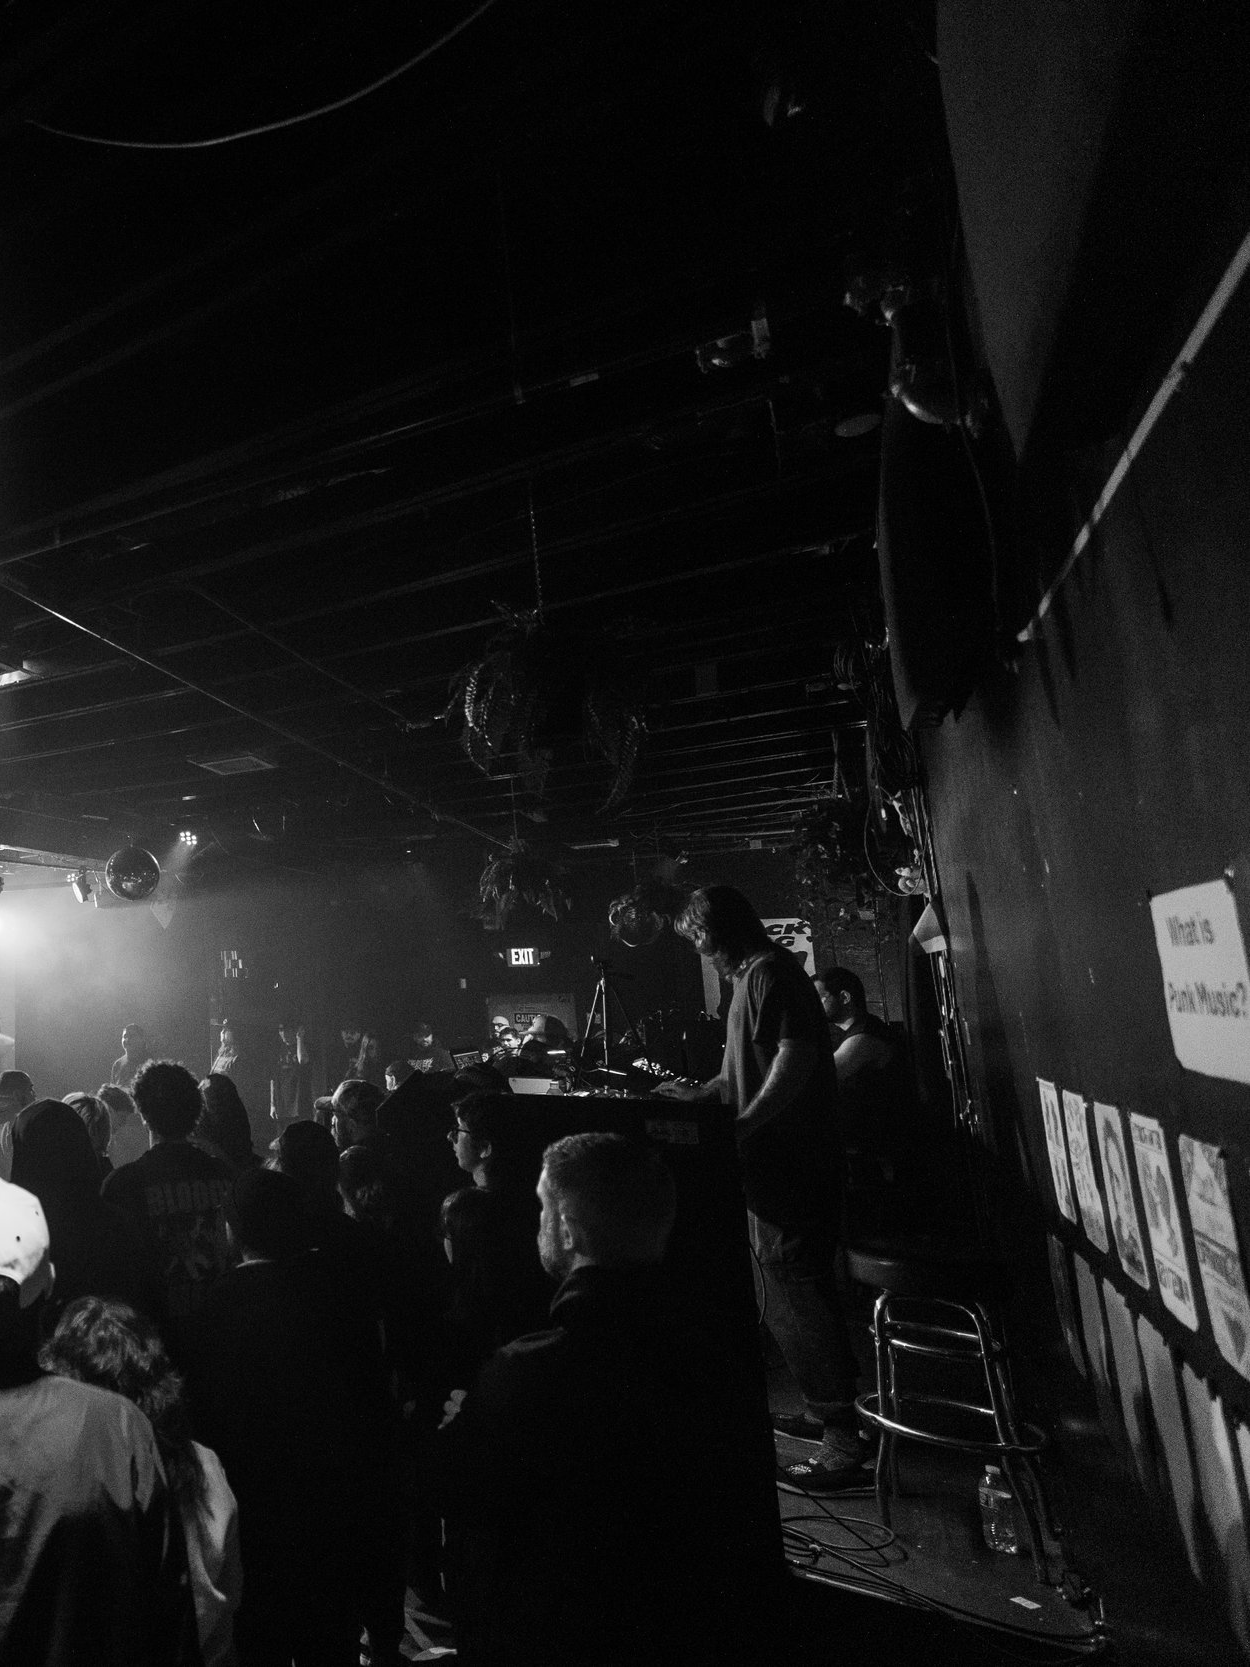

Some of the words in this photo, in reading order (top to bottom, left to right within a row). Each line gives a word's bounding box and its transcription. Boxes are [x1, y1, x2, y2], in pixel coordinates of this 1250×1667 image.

[1165, 915, 1199, 947] What
[1196, 911, 1215, 945] is
[510, 948, 534, 965] EXIT
[1168, 981, 1196, 1014] Punk
[1193, 981, 1247, 1019] Music?
